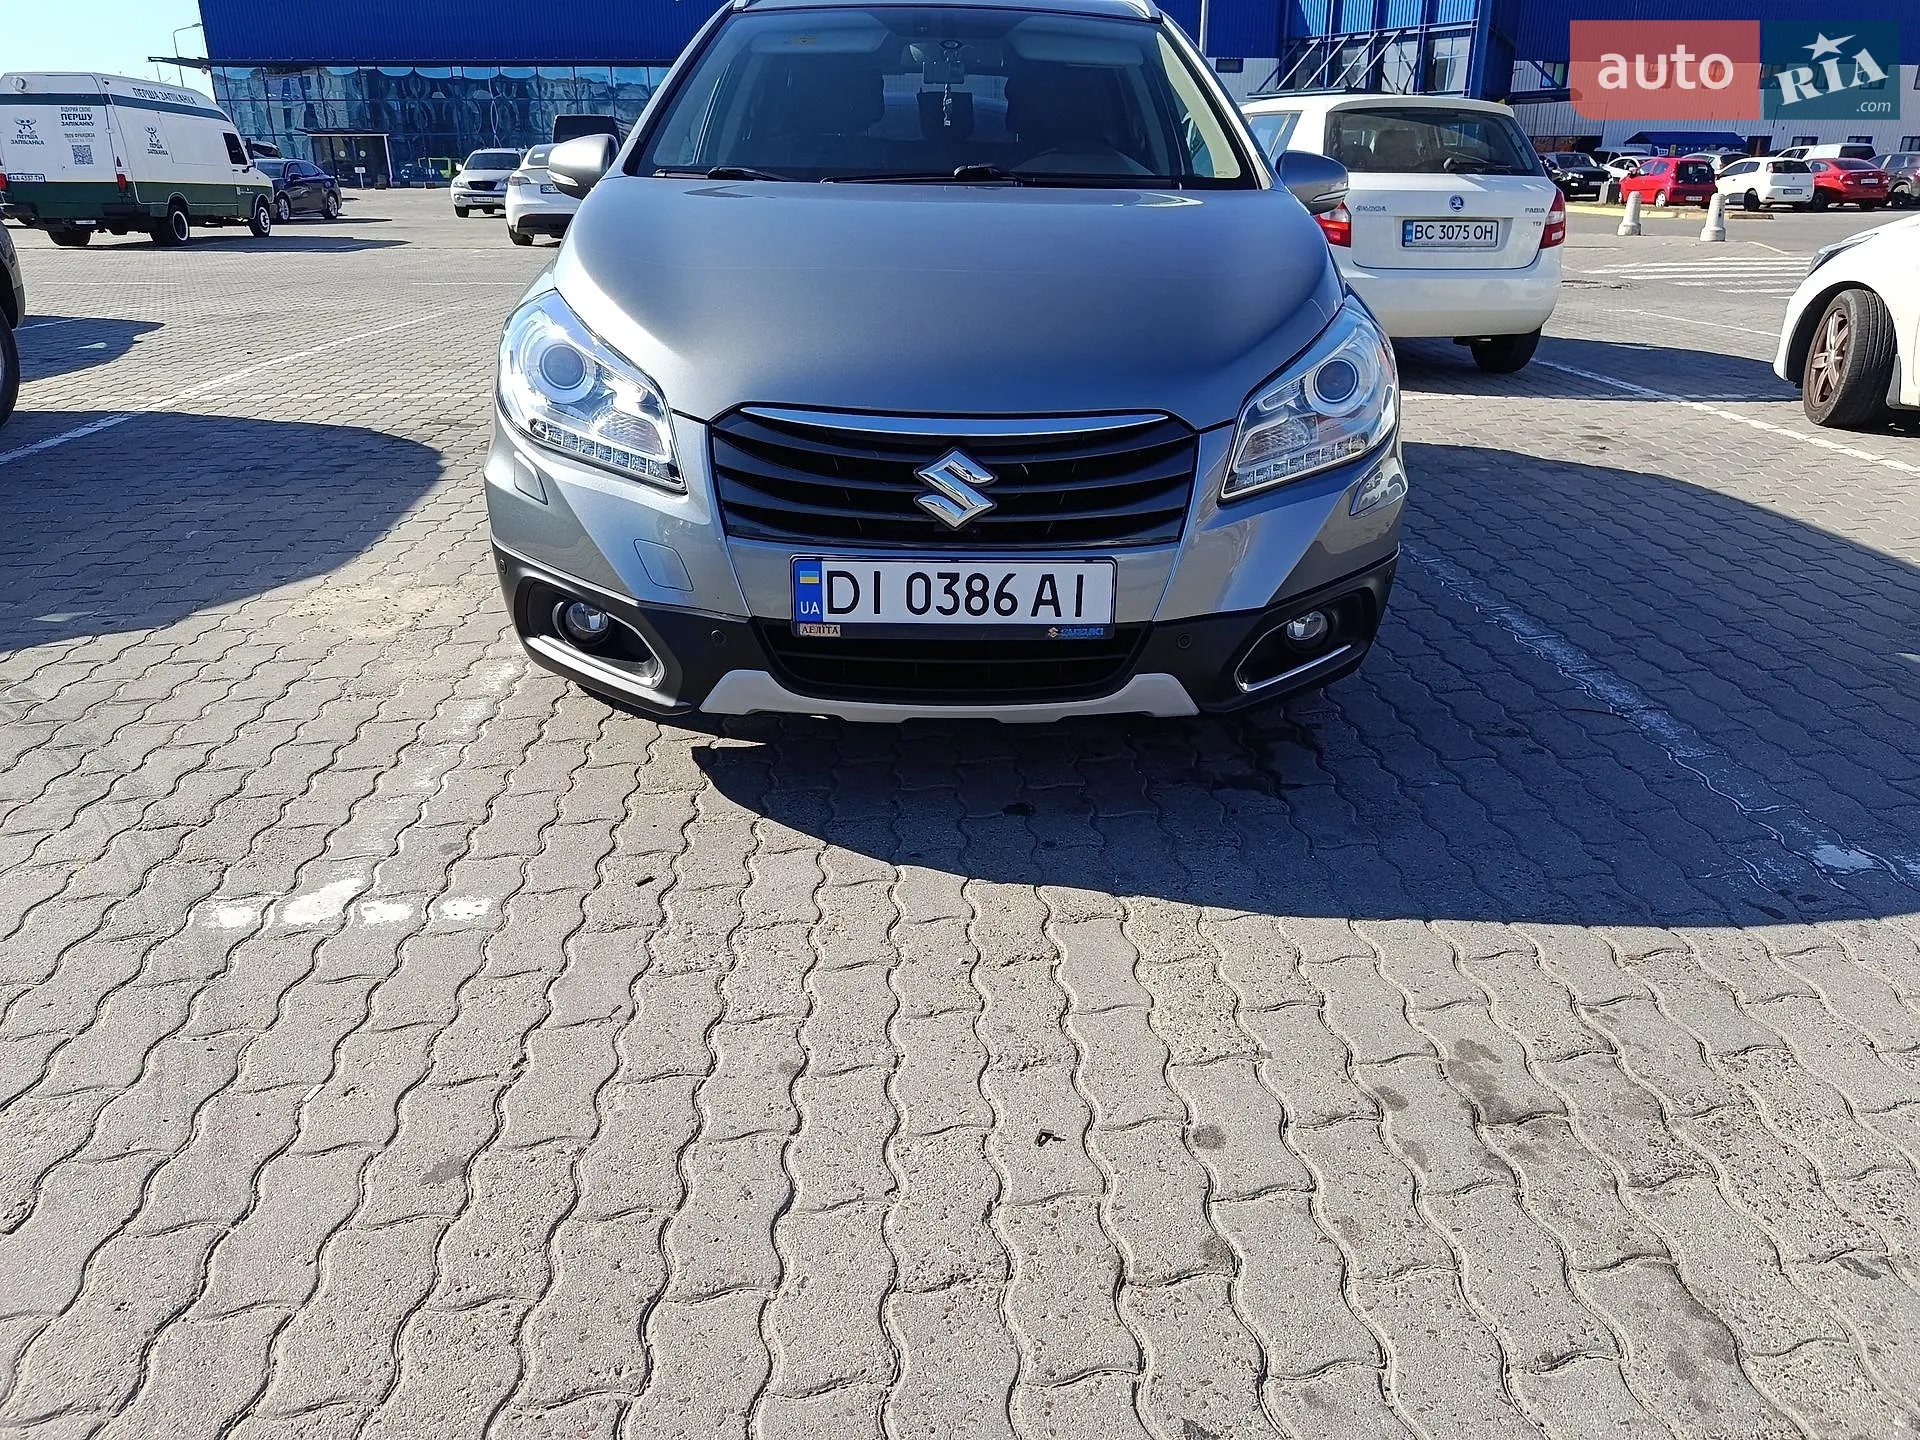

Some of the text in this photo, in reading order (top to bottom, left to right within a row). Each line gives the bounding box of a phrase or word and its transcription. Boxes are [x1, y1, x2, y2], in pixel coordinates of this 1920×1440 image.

[132, 87, 161, 101] ПЕРША
[60, 113, 93, 121] ПЕРШУ
[1414, 224, 1493, 240] BC 3075 OH
[827, 570, 1084, 618] DI 0386 AI
[800, 601, 820, 616] UA
